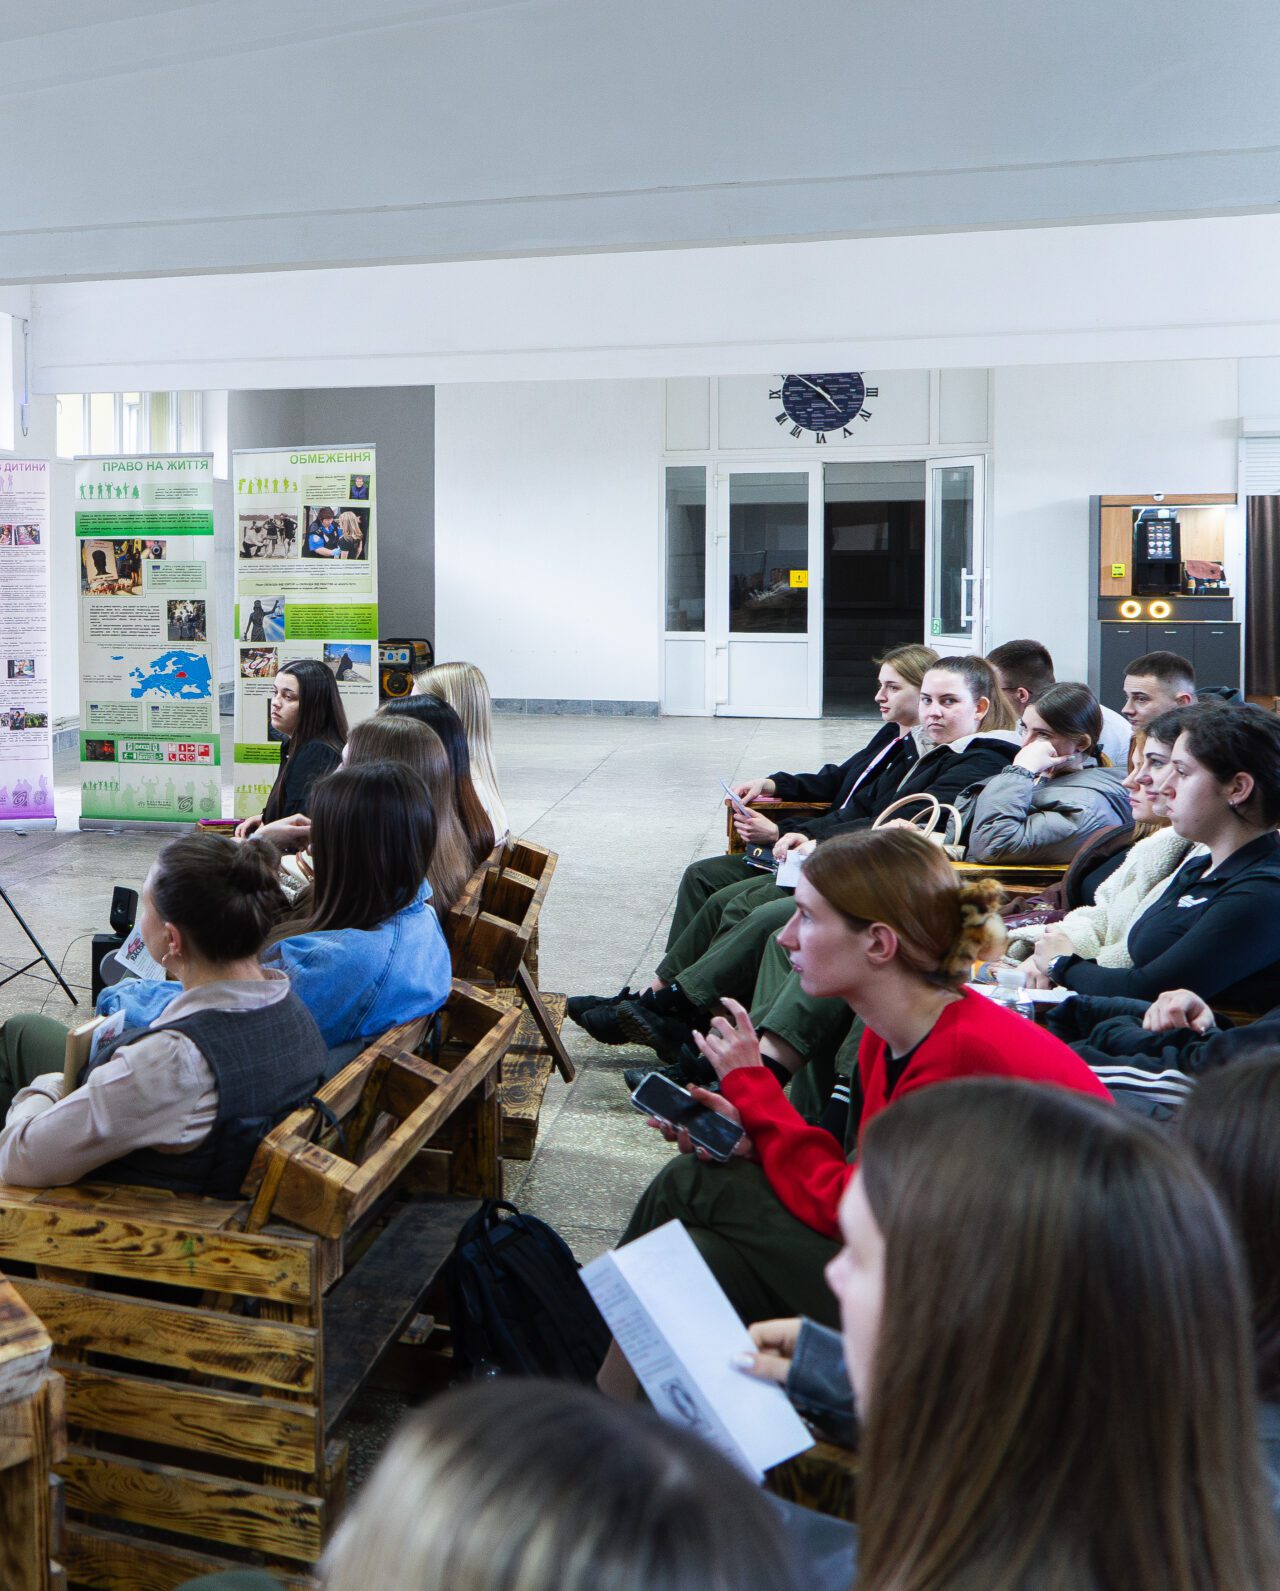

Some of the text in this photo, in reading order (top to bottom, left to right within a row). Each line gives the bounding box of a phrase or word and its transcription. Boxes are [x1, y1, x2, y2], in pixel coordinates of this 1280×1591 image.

[290, 452, 371, 464] ОБМЕЖЕННЯ
[4, 463, 46, 472] ДИТИНИ
[103, 460, 209, 472] ПРАВО НА ЖИТТЯ
